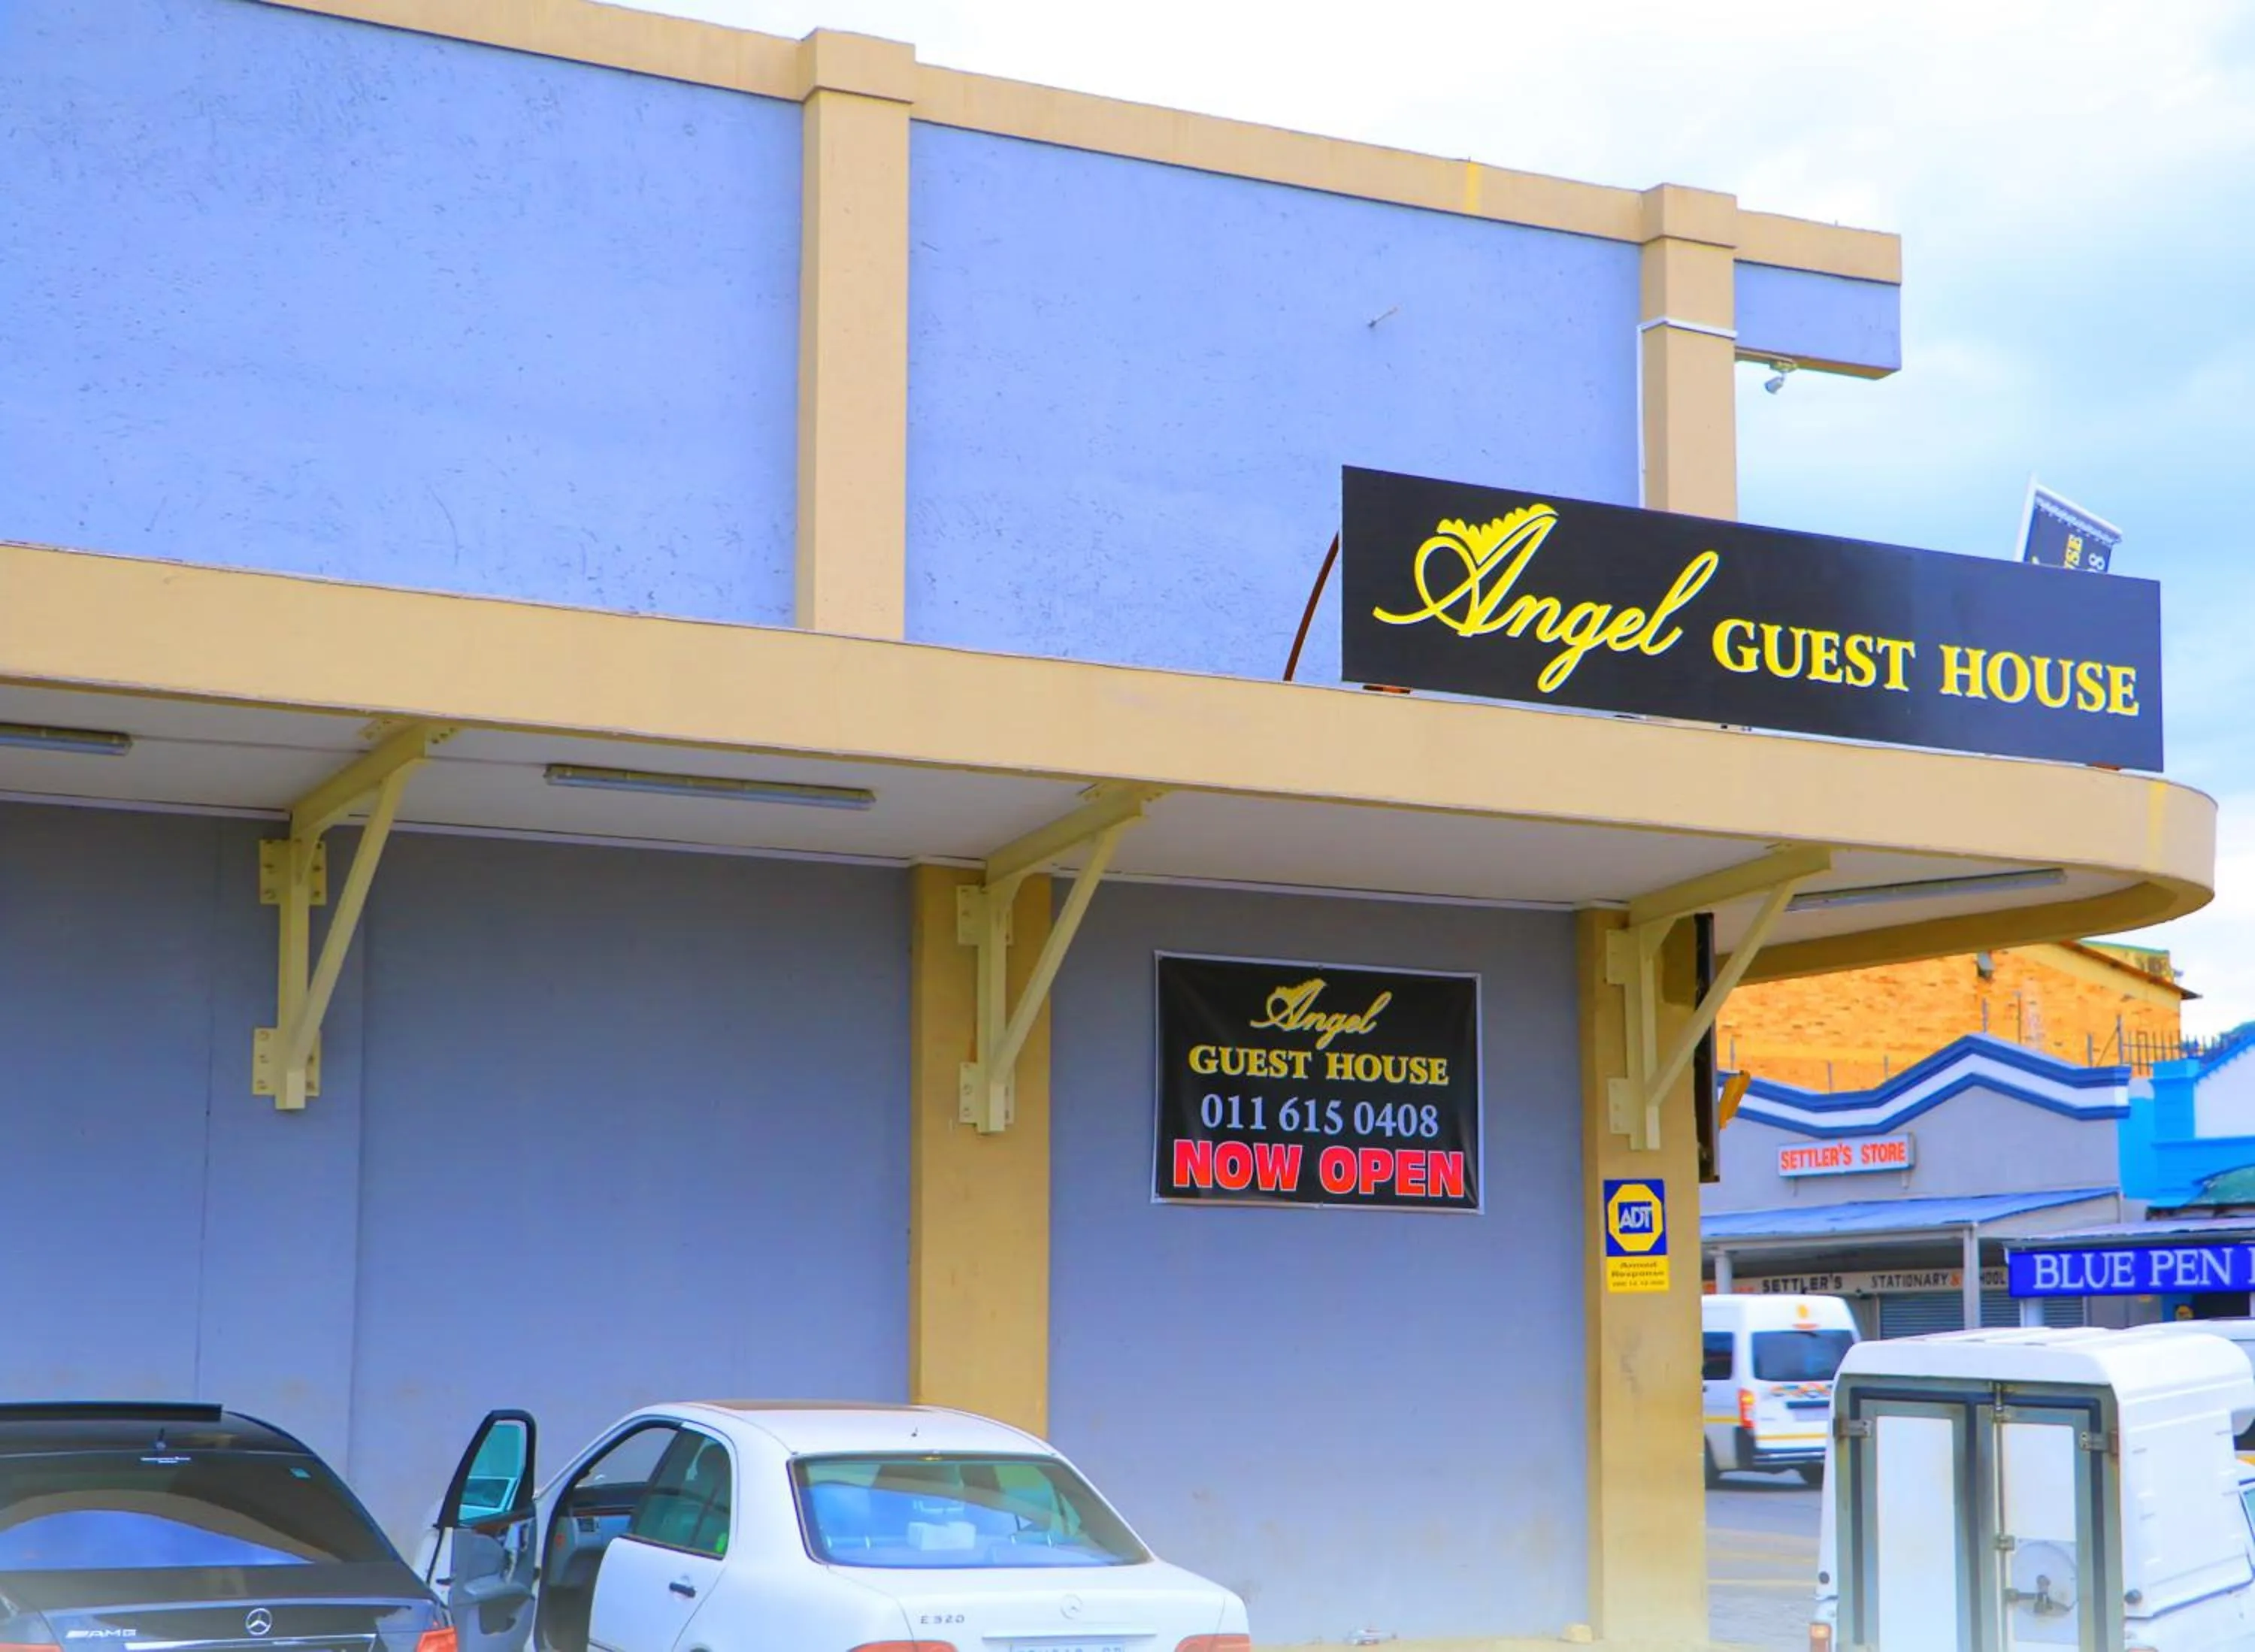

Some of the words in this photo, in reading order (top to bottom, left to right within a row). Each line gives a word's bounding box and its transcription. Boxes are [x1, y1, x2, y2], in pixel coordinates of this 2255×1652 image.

[1373, 504, 1719, 693] Angel
[1712, 619, 1914, 691] GUEST
[1939, 643, 2139, 716] HOUSE
[1250, 978, 1393, 1049] Angel
[1188, 1045, 1312, 1079] GUEST
[1325, 1051, 1450, 1085] HOUSE
[1201, 1094, 1267, 1130] 011
[1279, 1097, 1344, 1136] 615
[1354, 1101, 1439, 1138] 0408
[1173, 1139, 1303, 1193] NOW
[1319, 1145, 1465, 1198] OPEN
[1781, 1144, 1853, 1171] SETTLER'S
[1861, 1142, 1906, 1164] STORE
[1618, 1206, 1651, 1230] ADT
[1762, 1273, 1843, 1293] SETTLER'S
[1870, 1272, 1949, 1289] STATIONARY
[2032, 1250, 2135, 1290] BLUE
[2148, 1247, 2234, 1287] PEN
